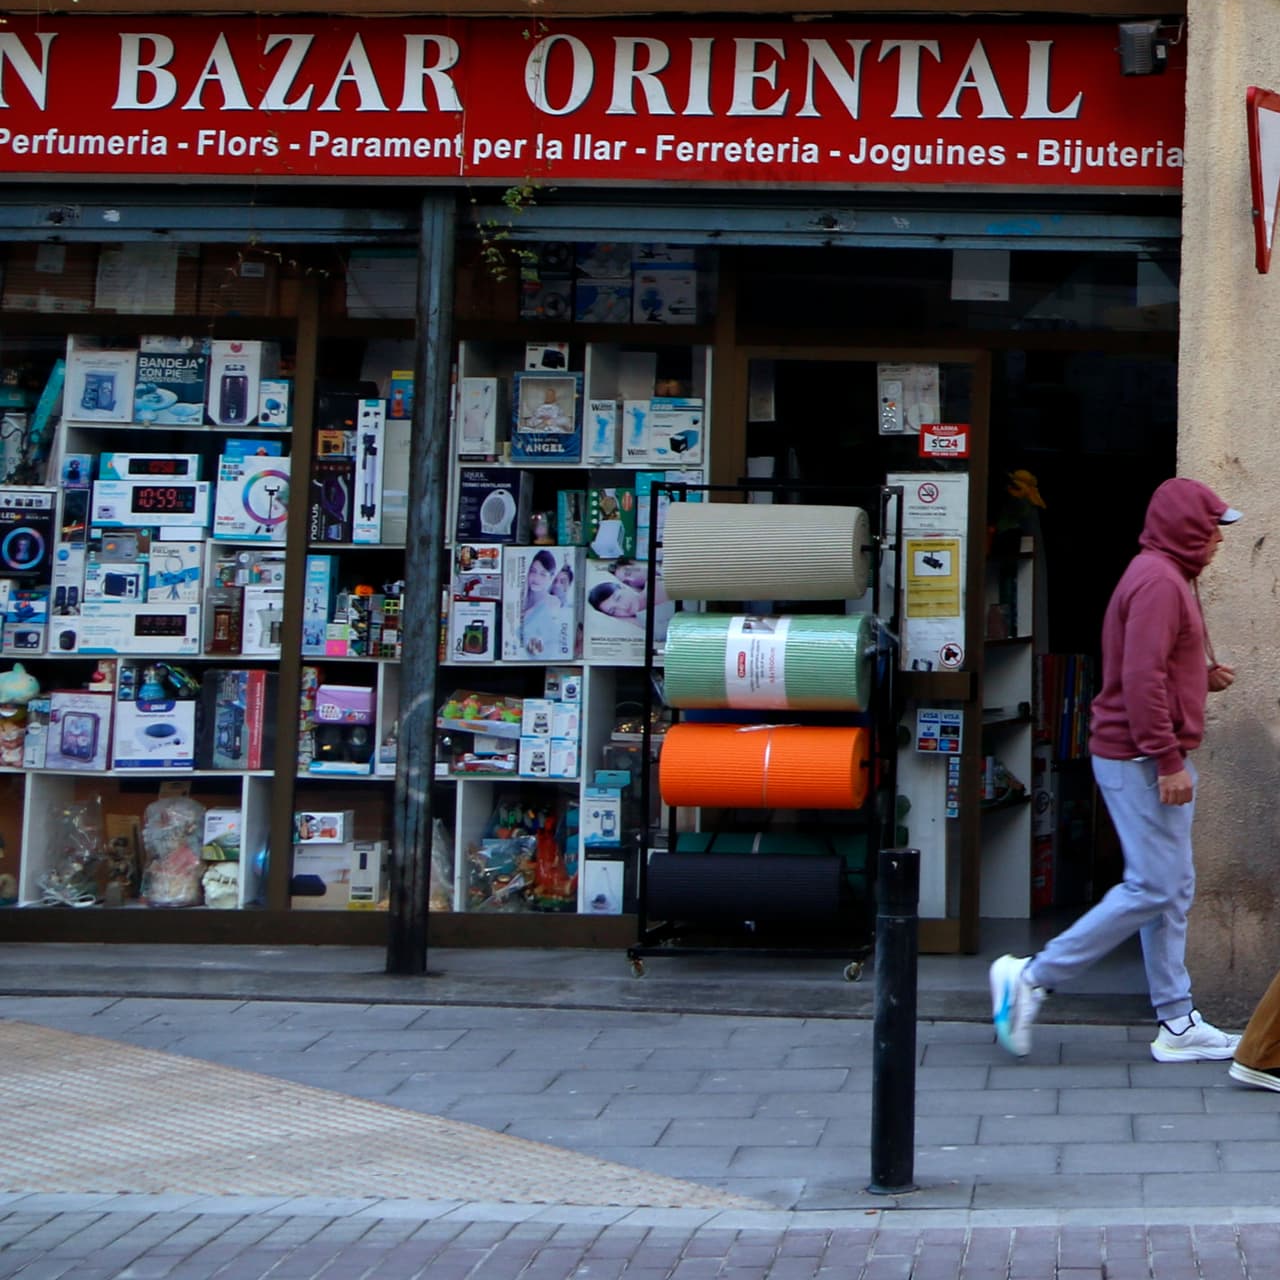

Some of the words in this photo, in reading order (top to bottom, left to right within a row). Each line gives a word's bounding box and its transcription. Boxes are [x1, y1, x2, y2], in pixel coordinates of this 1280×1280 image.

[111, 32, 465, 113] BAZAR
[524, 36, 1083, 120] ORIENTAL
[197, 129, 279, 157] Flors
[309, 130, 463, 159] Parament
[473, 138, 528, 165] per
[535, 133, 563, 160] la
[573, 133, 627, 161] llar
[655, 134, 819, 164] Ferreteria
[848, 137, 1006, 172] Joguines
[1037, 139, 1184, 174] Bijuteria
[139, 356, 198, 368] BANDEJA
[525, 442, 566, 453] ANGEL
[310, 503, 320, 541] novus
